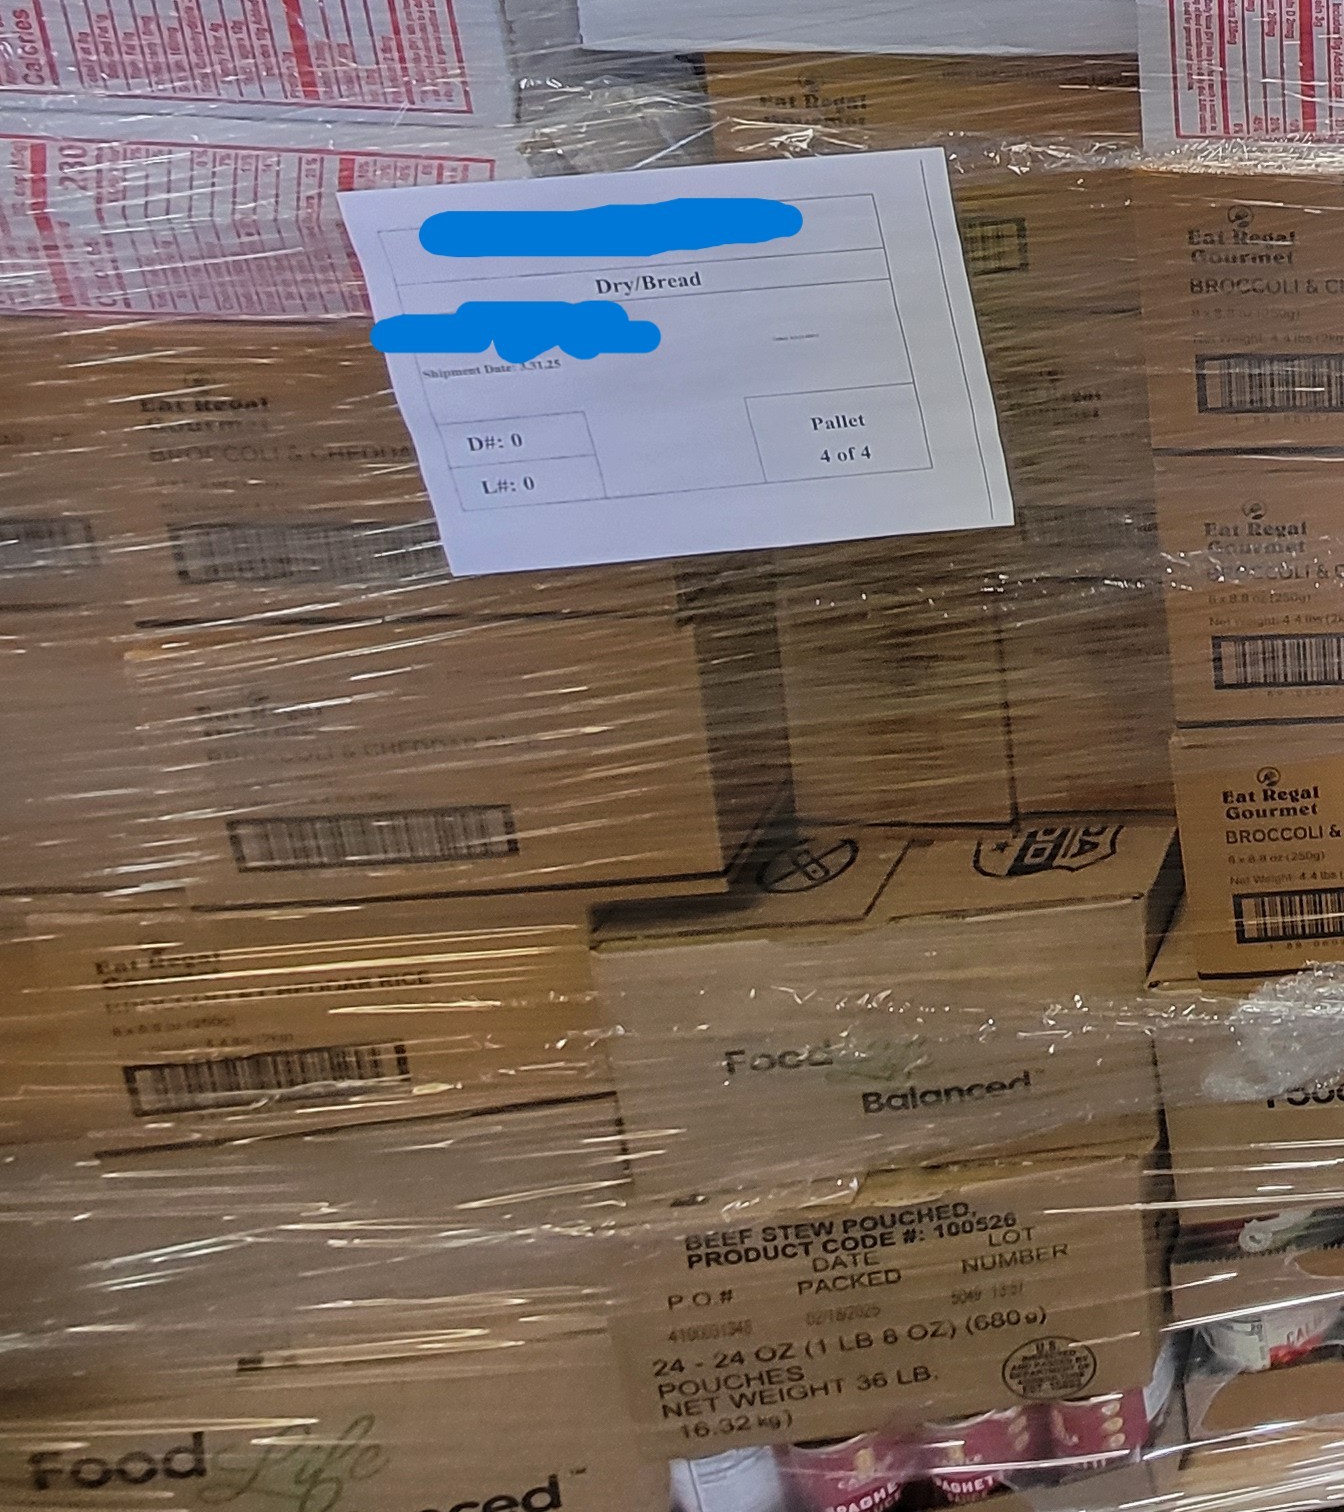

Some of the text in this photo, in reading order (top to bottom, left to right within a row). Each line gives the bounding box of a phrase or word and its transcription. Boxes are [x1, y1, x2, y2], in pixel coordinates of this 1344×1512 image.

[1313, 15, 1325, 28] 3g
[595, 271, 702, 297] Dry/Bread
[421, 362, 483, 381] Shipment
[809, 413, 866, 432] Pallet
[466, 432, 524, 453] D#: 0
[819, 444, 872, 463] 4 of 4
[481, 474, 536, 497] L#: 0
[1248, 520, 1308, 537] Regal
[1221, 785, 1321, 805] Eat Regal
[1225, 802, 1319, 822] Gourmet
[1225, 824, 1324, 846] BROCCOLI
[1328, 824, 1342, 839] &
[684, 1201, 978, 1252] BEEF STEW POUCHED,
[988, 1226, 1036, 1248] LOT
[686, 1241, 812, 1270] PRODUCT
[817, 1231, 897, 1254] CODE
[932, 1212, 1018, 1240] 100526
[811, 1252, 881, 1273] DATE
[961, 1243, 1069, 1275] NUMBER
[797, 1268, 903, 1296] PACKED
[652, 1359, 686, 1378] 24
[714, 1350, 746, 1369] 24
[754, 1345, 798, 1362] OZ
[838, 1331, 874, 1351] LB
[906, 1318, 957, 1342] OZ)
[656, 1366, 806, 1401] POUCHES
[661, 1396, 718, 1420] NET
[732, 1377, 844, 1411] WEIGHT
[855, 1373, 888, 1391] 36
[26, 1430, 208, 1490] Food
